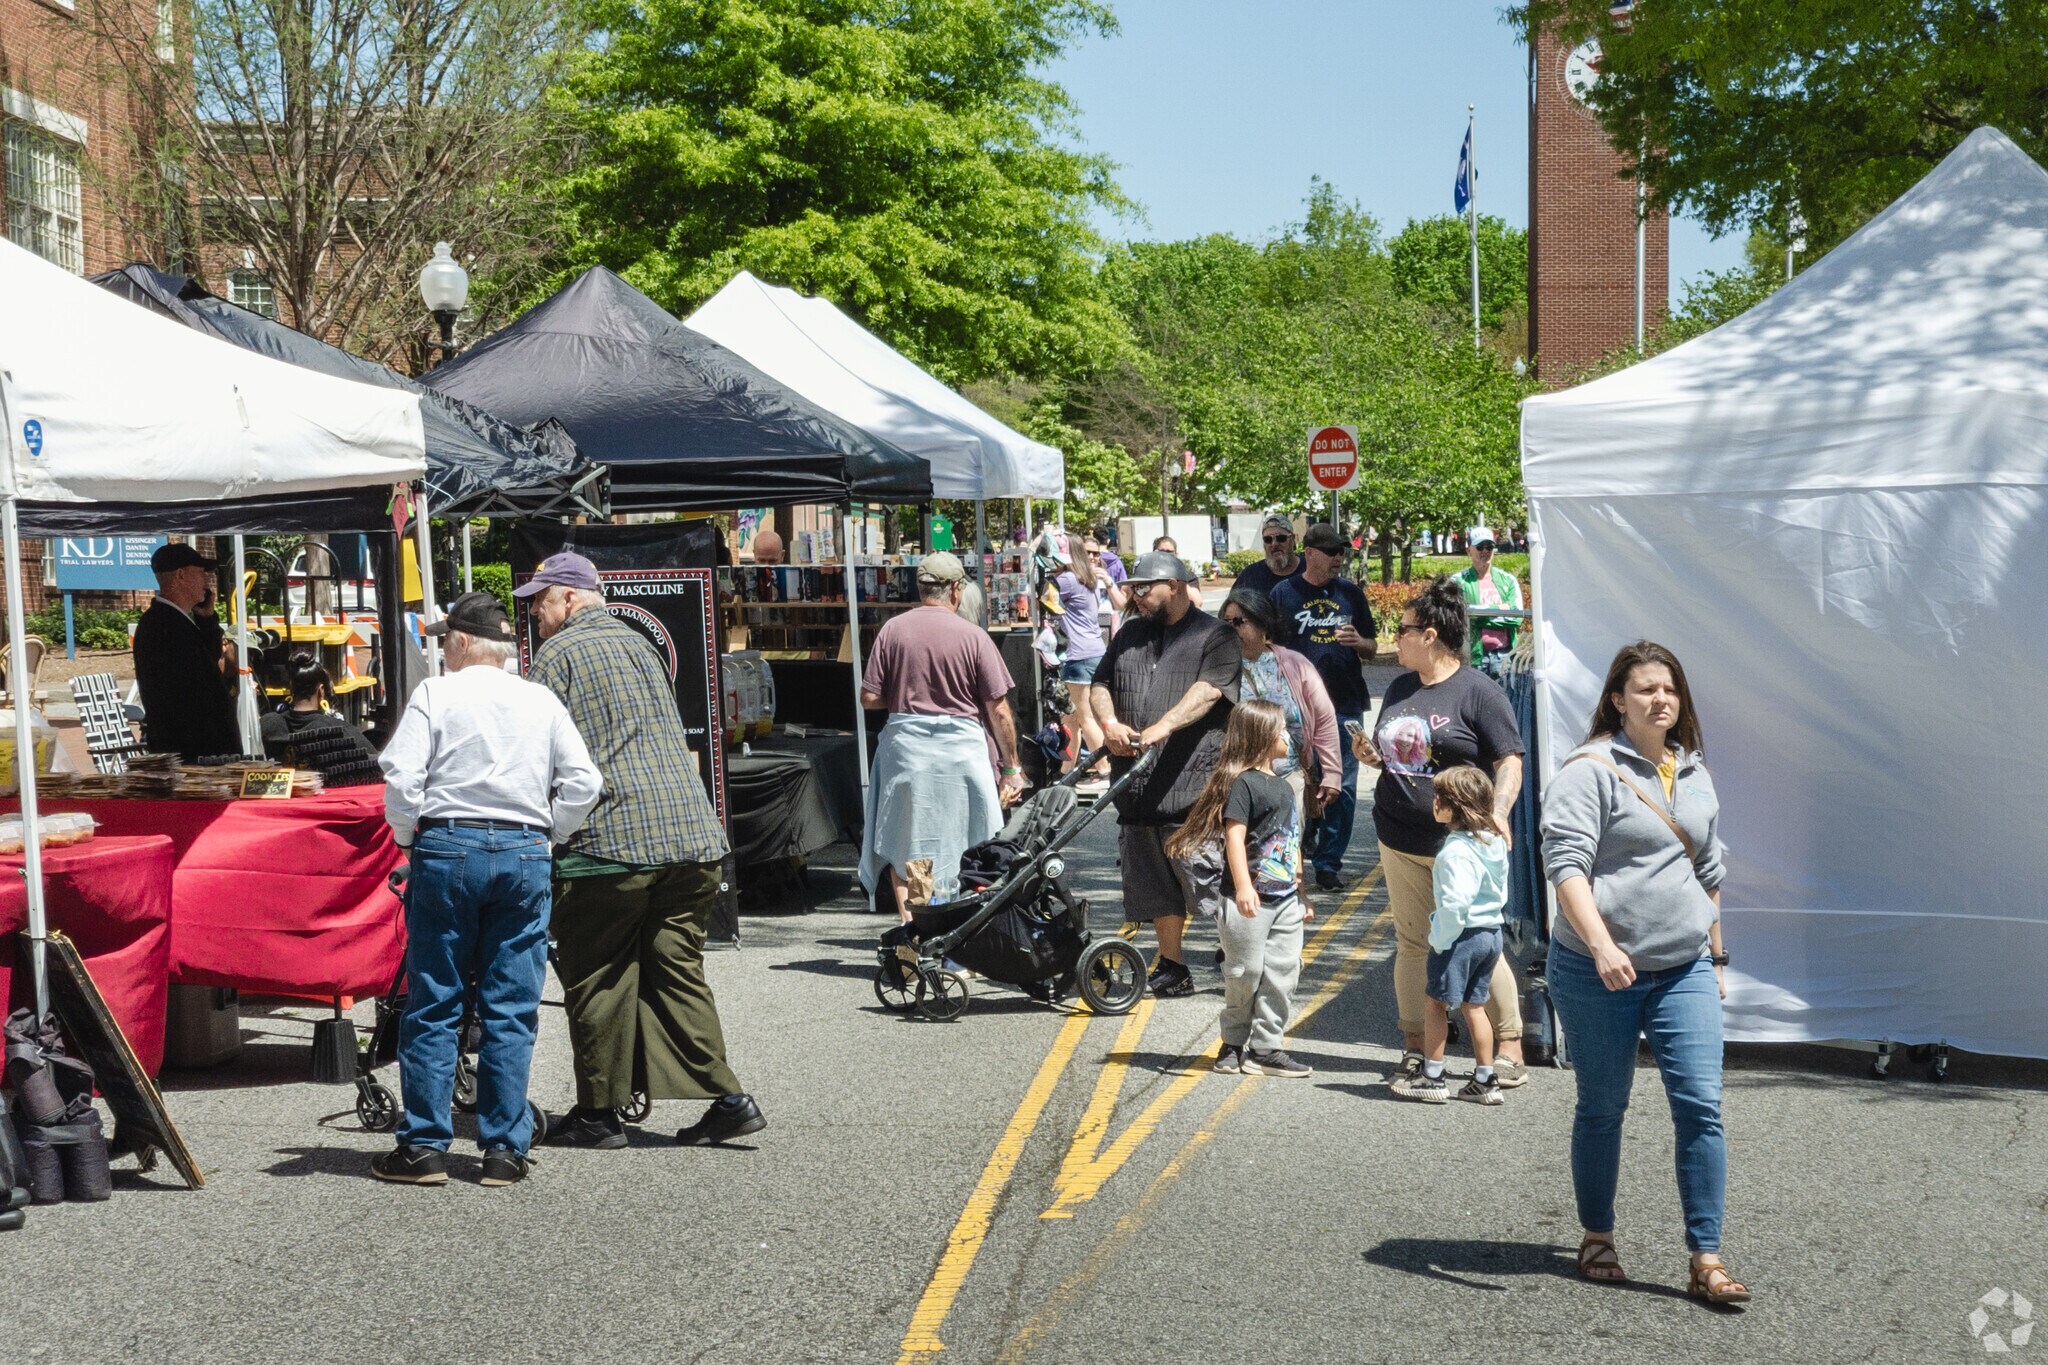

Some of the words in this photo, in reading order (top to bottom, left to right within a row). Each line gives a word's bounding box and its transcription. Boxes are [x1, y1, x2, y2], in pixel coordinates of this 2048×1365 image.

[1315, 440, 1328, 450] DO
[1331, 439, 1350, 449] NOT
[1319, 467, 1347, 478] ENTER
[613, 584, 684, 597] MASCULINE
[621, 608, 665, 646] MANHOOD
[1294, 610, 1348, 635] Fender
[688, 727, 705, 735] SOAP
